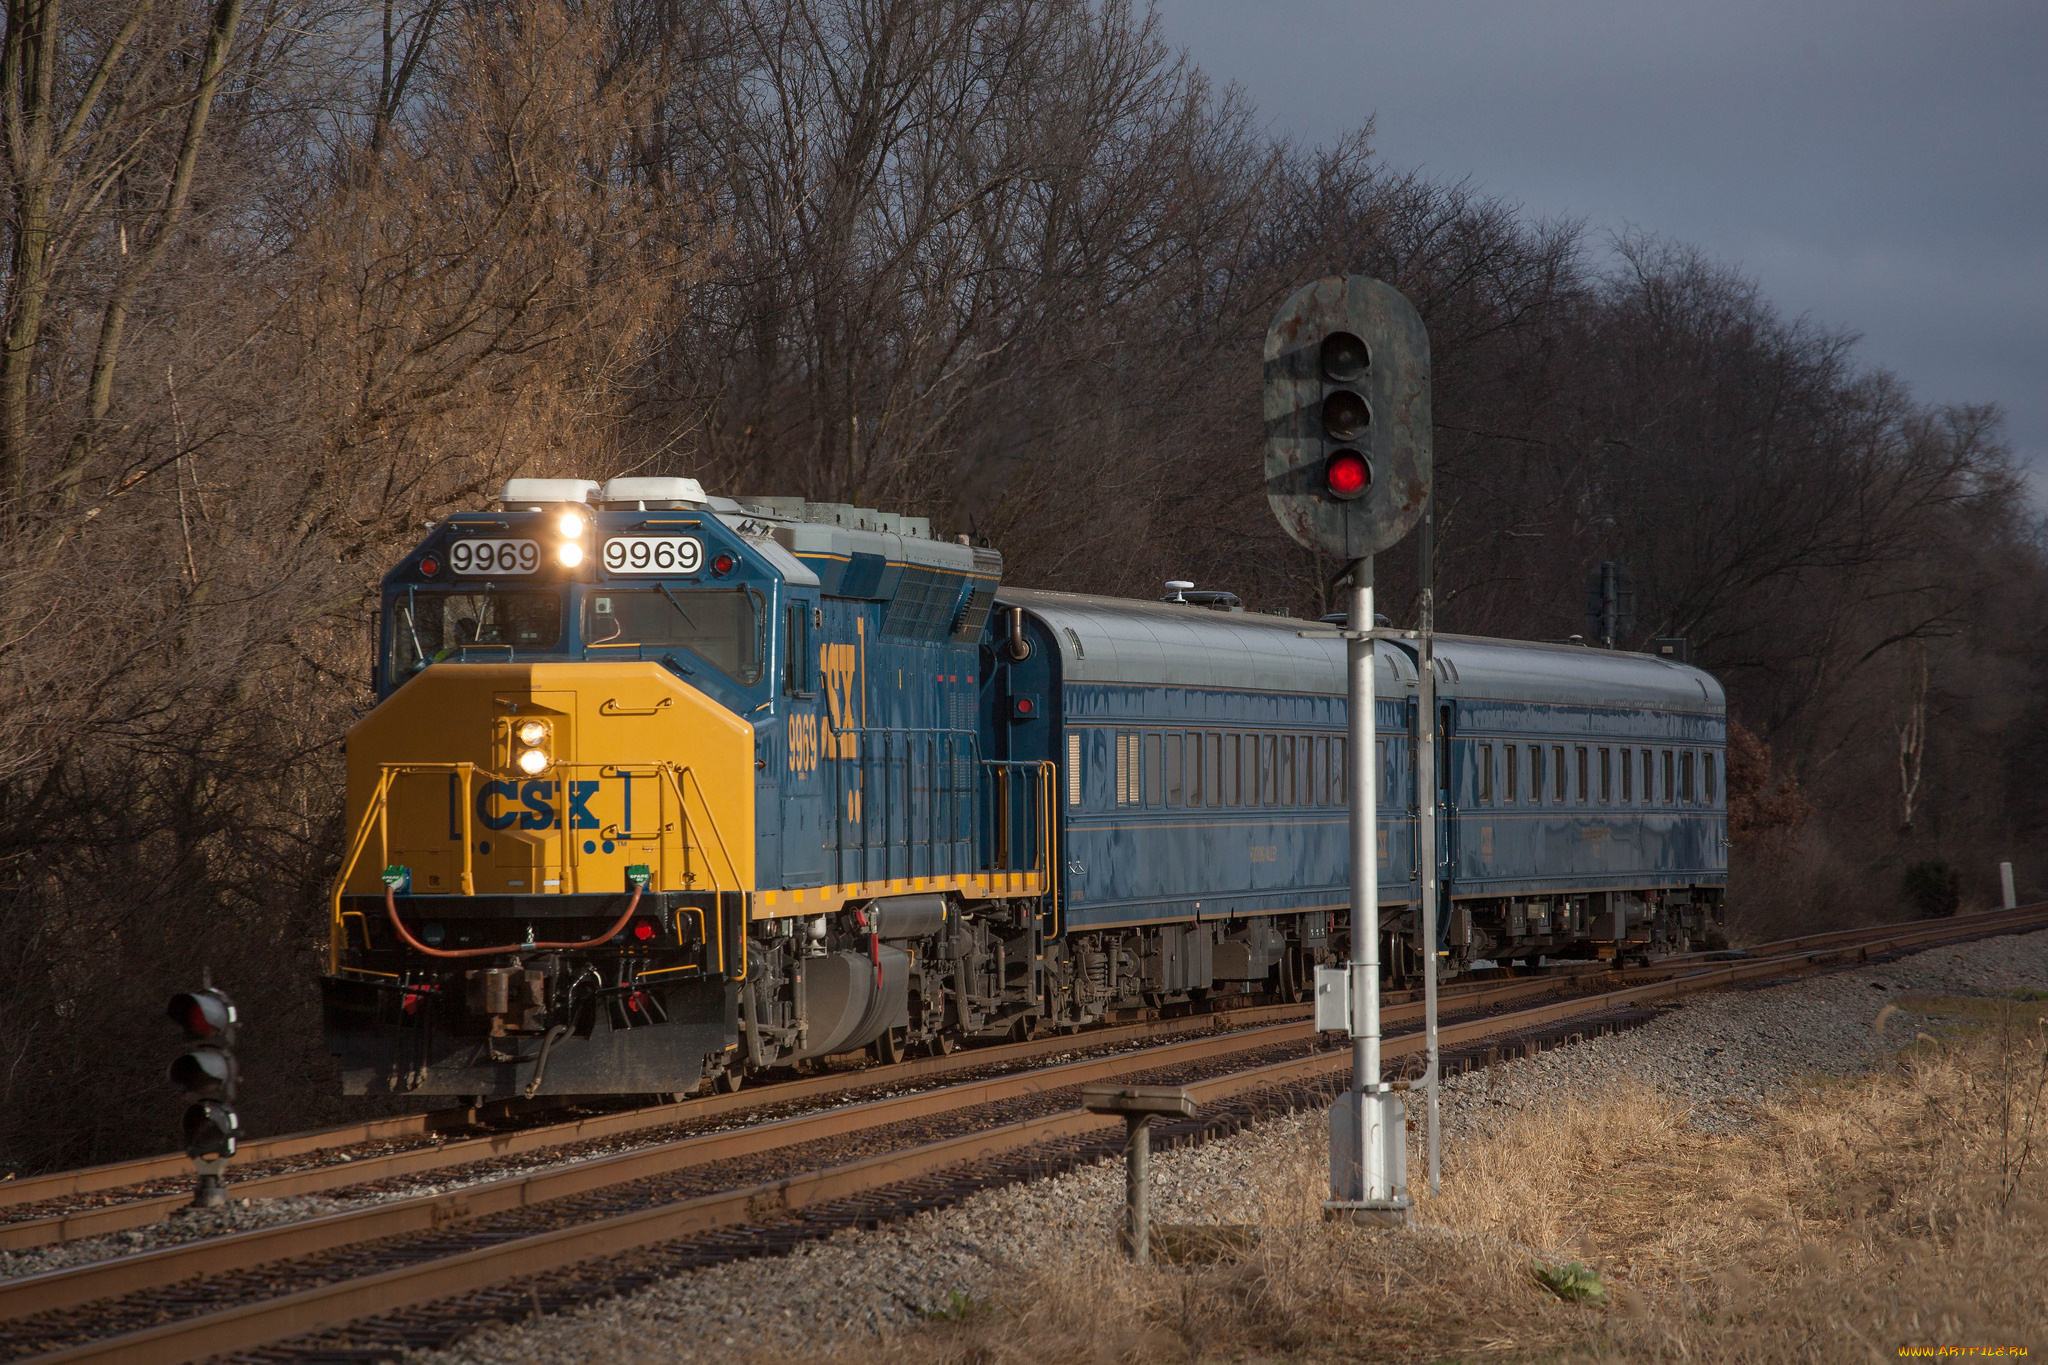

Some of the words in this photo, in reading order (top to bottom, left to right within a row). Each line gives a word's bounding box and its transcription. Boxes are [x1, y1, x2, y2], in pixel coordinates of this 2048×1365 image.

[453, 543, 538, 571] 9969
[606, 541, 699, 569] 9969
[788, 713, 817, 772] 9969
[476, 780, 600, 831] CSX
